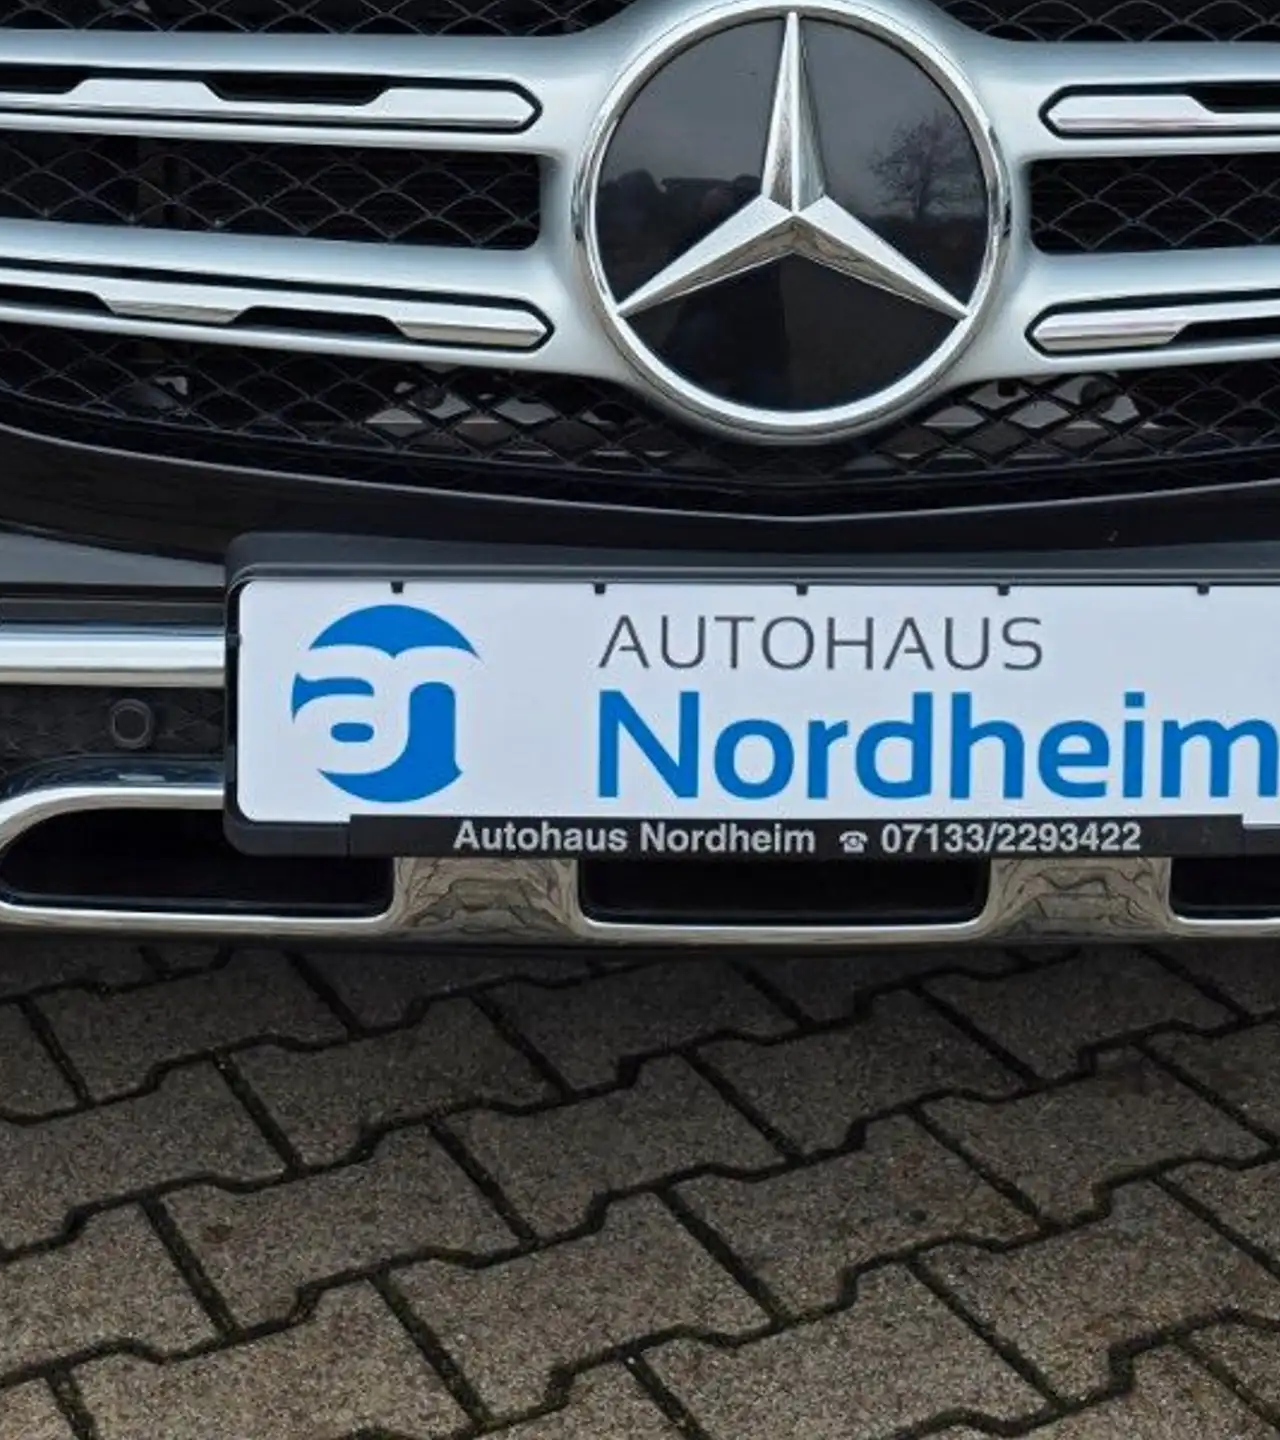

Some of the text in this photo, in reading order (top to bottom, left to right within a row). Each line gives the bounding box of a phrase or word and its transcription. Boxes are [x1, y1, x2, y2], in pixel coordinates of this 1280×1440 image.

[599, 615, 1042, 670] AUTOHAUS
[599, 690, 1279, 799] Nordheim
[454, 820, 1140, 852] Autohaus Nordheim 07133/2293422
